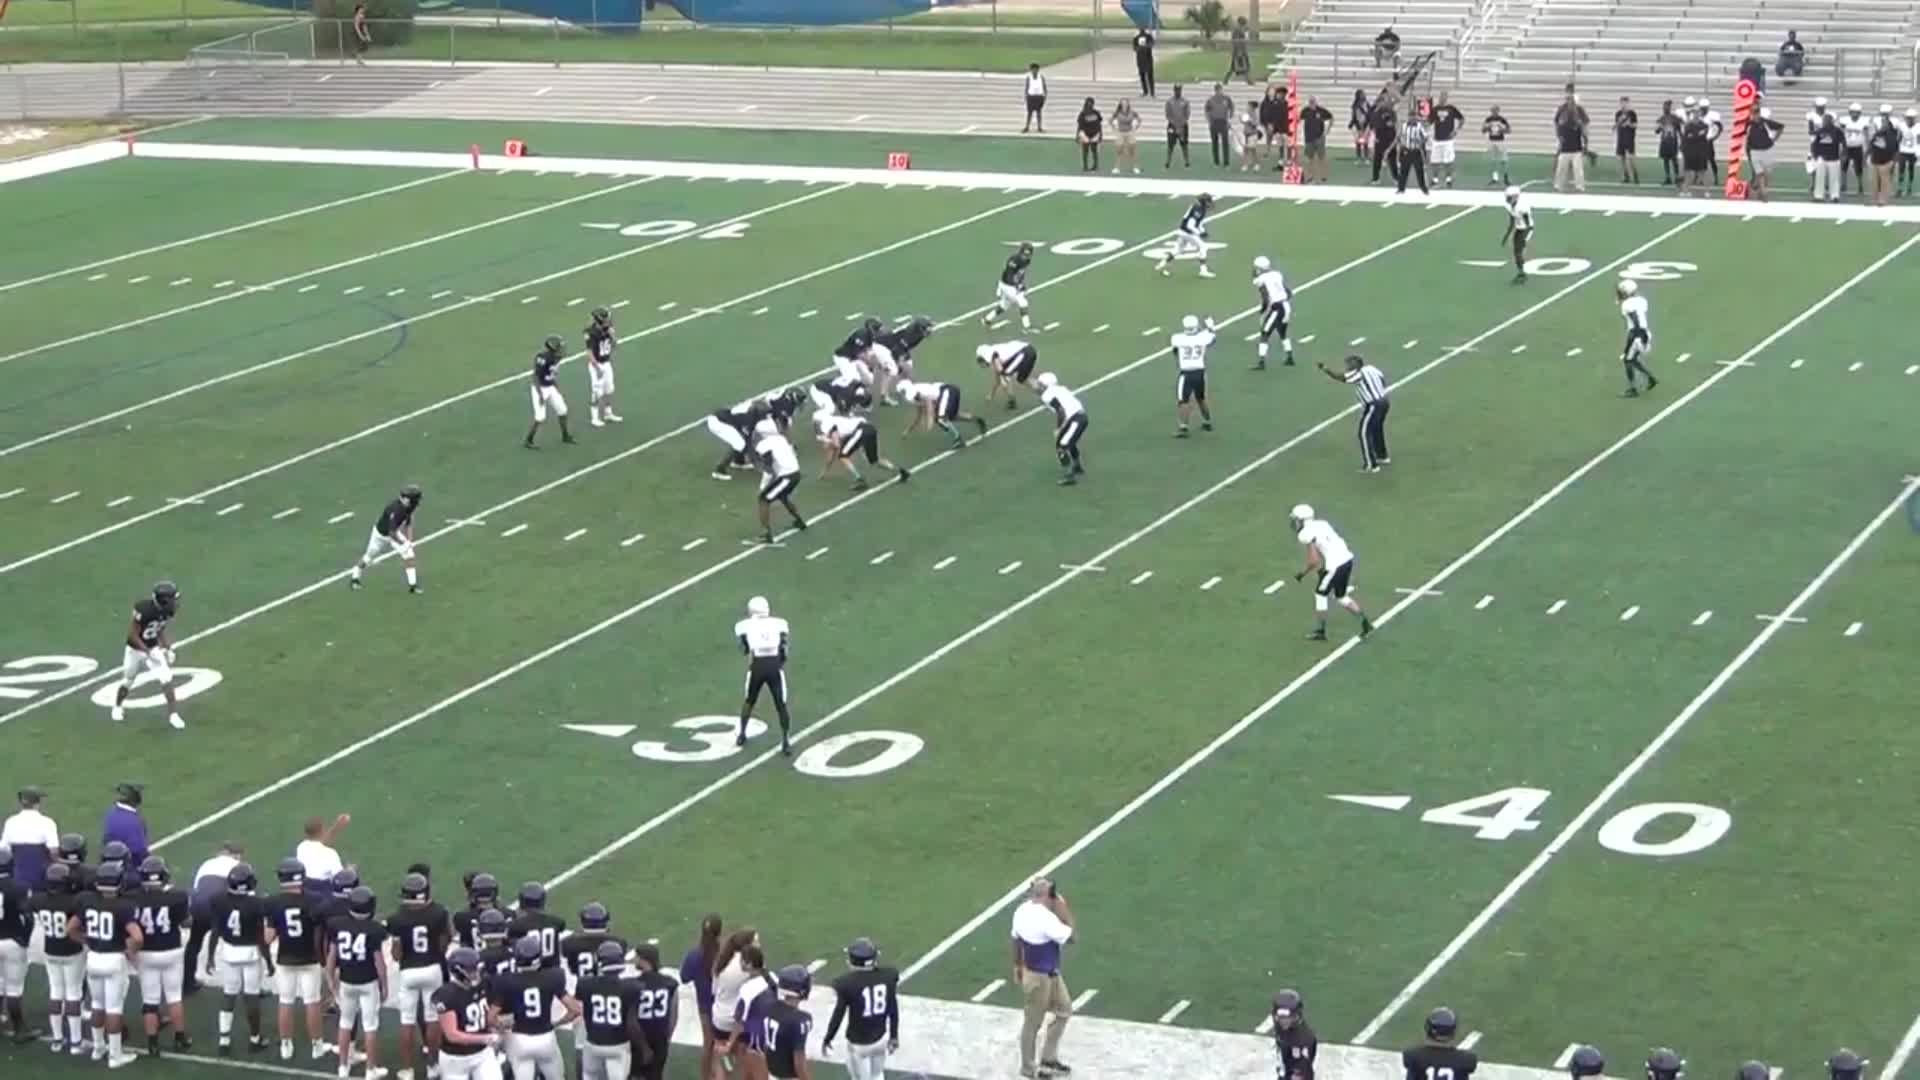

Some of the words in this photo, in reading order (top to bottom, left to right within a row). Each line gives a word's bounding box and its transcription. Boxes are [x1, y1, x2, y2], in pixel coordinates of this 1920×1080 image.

[632, 715, 925, 777] 30
[1420, 787, 1732, 856] 40
[85, 908, 113, 940] 20
[141, 906, 171, 934] 44
[227, 909, 241, 936] 4
[285, 908, 303, 937] 5
[337, 931, 367, 961] 24
[412, 926, 428, 953] 6
[523, 988, 541, 1017] 9
[591, 994, 622, 1025] 28
[638, 989, 669, 1018] 23
[861, 984, 887, 1017] 18
[763, 1016, 780, 1051] 17
